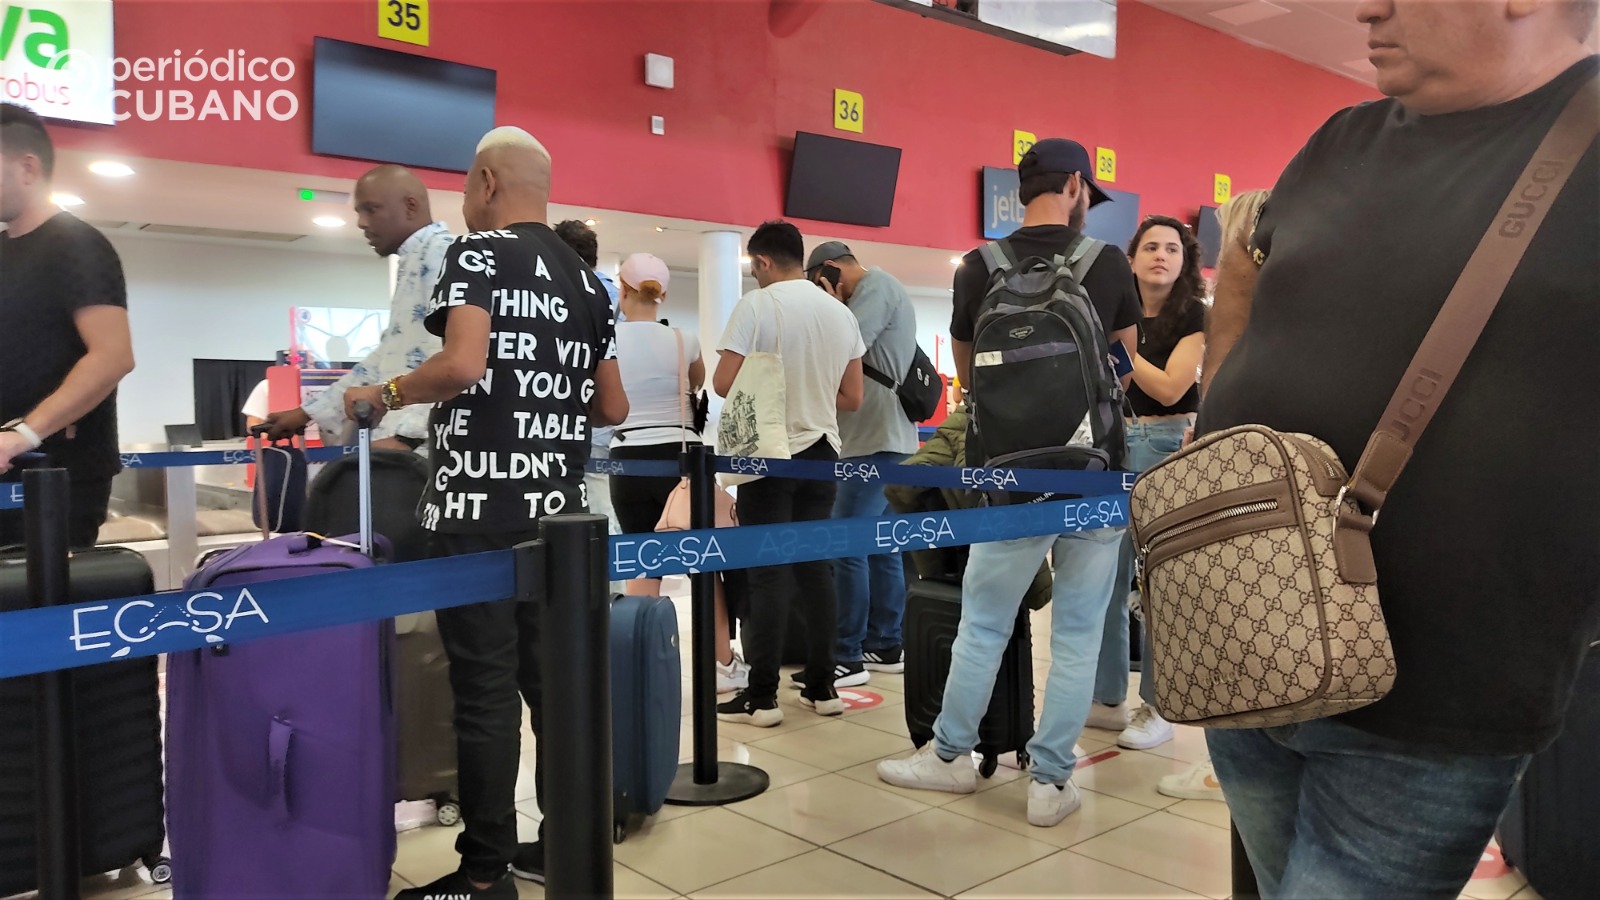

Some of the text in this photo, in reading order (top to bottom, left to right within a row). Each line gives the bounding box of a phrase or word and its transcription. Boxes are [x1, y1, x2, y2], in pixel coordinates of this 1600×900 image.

[387, 0, 420, 31] 35
[0, 72, 70, 105] obus
[839, 99, 860, 123] 36
[1099, 156, 1113, 174] 38
[1217, 181, 1228, 197] 39
[1499, 161, 1563, 238] GUCCI
[534, 254, 552, 281] A
[514, 369, 571, 400] YOU
[513, 411, 587, 441] TABLE
[524, 490, 566, 519] TO
